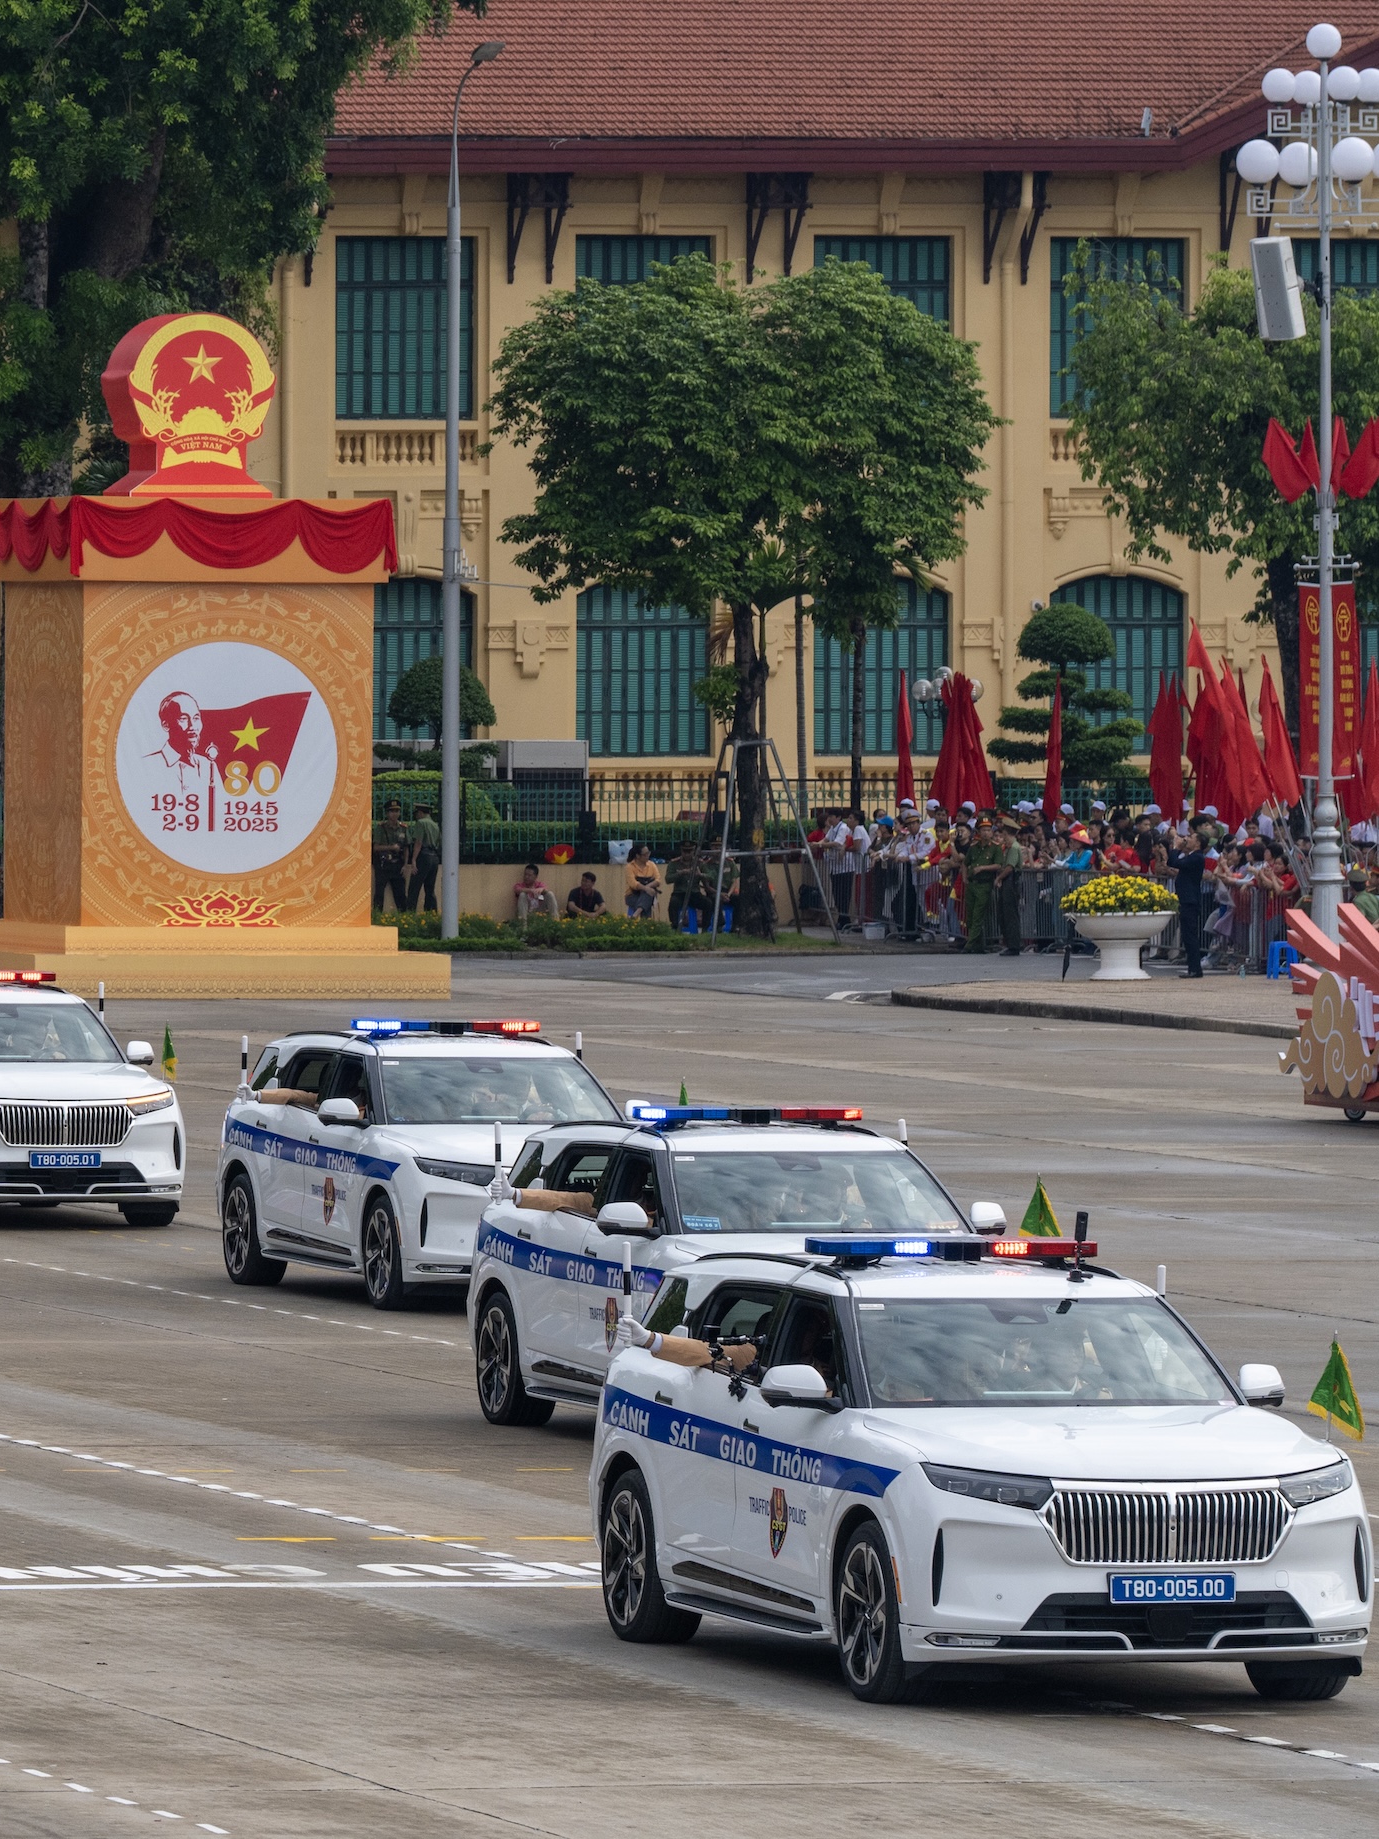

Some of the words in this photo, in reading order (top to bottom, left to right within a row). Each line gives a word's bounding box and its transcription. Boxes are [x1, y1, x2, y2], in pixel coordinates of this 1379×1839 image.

[181, 440, 201, 450] VIỆT
[203, 441, 222, 450] NAM
[224, 761, 282, 796] 80
[151, 794, 200, 811] 19-8
[224, 801, 279, 815] 1945
[162, 814, 200, 832] 2-9
[224, 817, 279, 832] 2025
[264, 1137, 283, 1158] SÁT
[295, 1147, 317, 1166] GIAO
[326, 1151, 356, 1172] THÔNG
[529, 1250, 552, 1275] SÁT
[567, 1260, 595, 1284] GIAO
[606, 1267, 644, 1291] THNG
[669, 1418, 700, 1450] SÁT
[720, 1434, 757, 1467] GIAO
[772, 1448, 821, 1484] THÔNG
[749, 1496, 770, 1516] TRAFFIC
[788, 1506, 806, 1526] POLICE
[772, 1520, 786, 1531] CSGT
